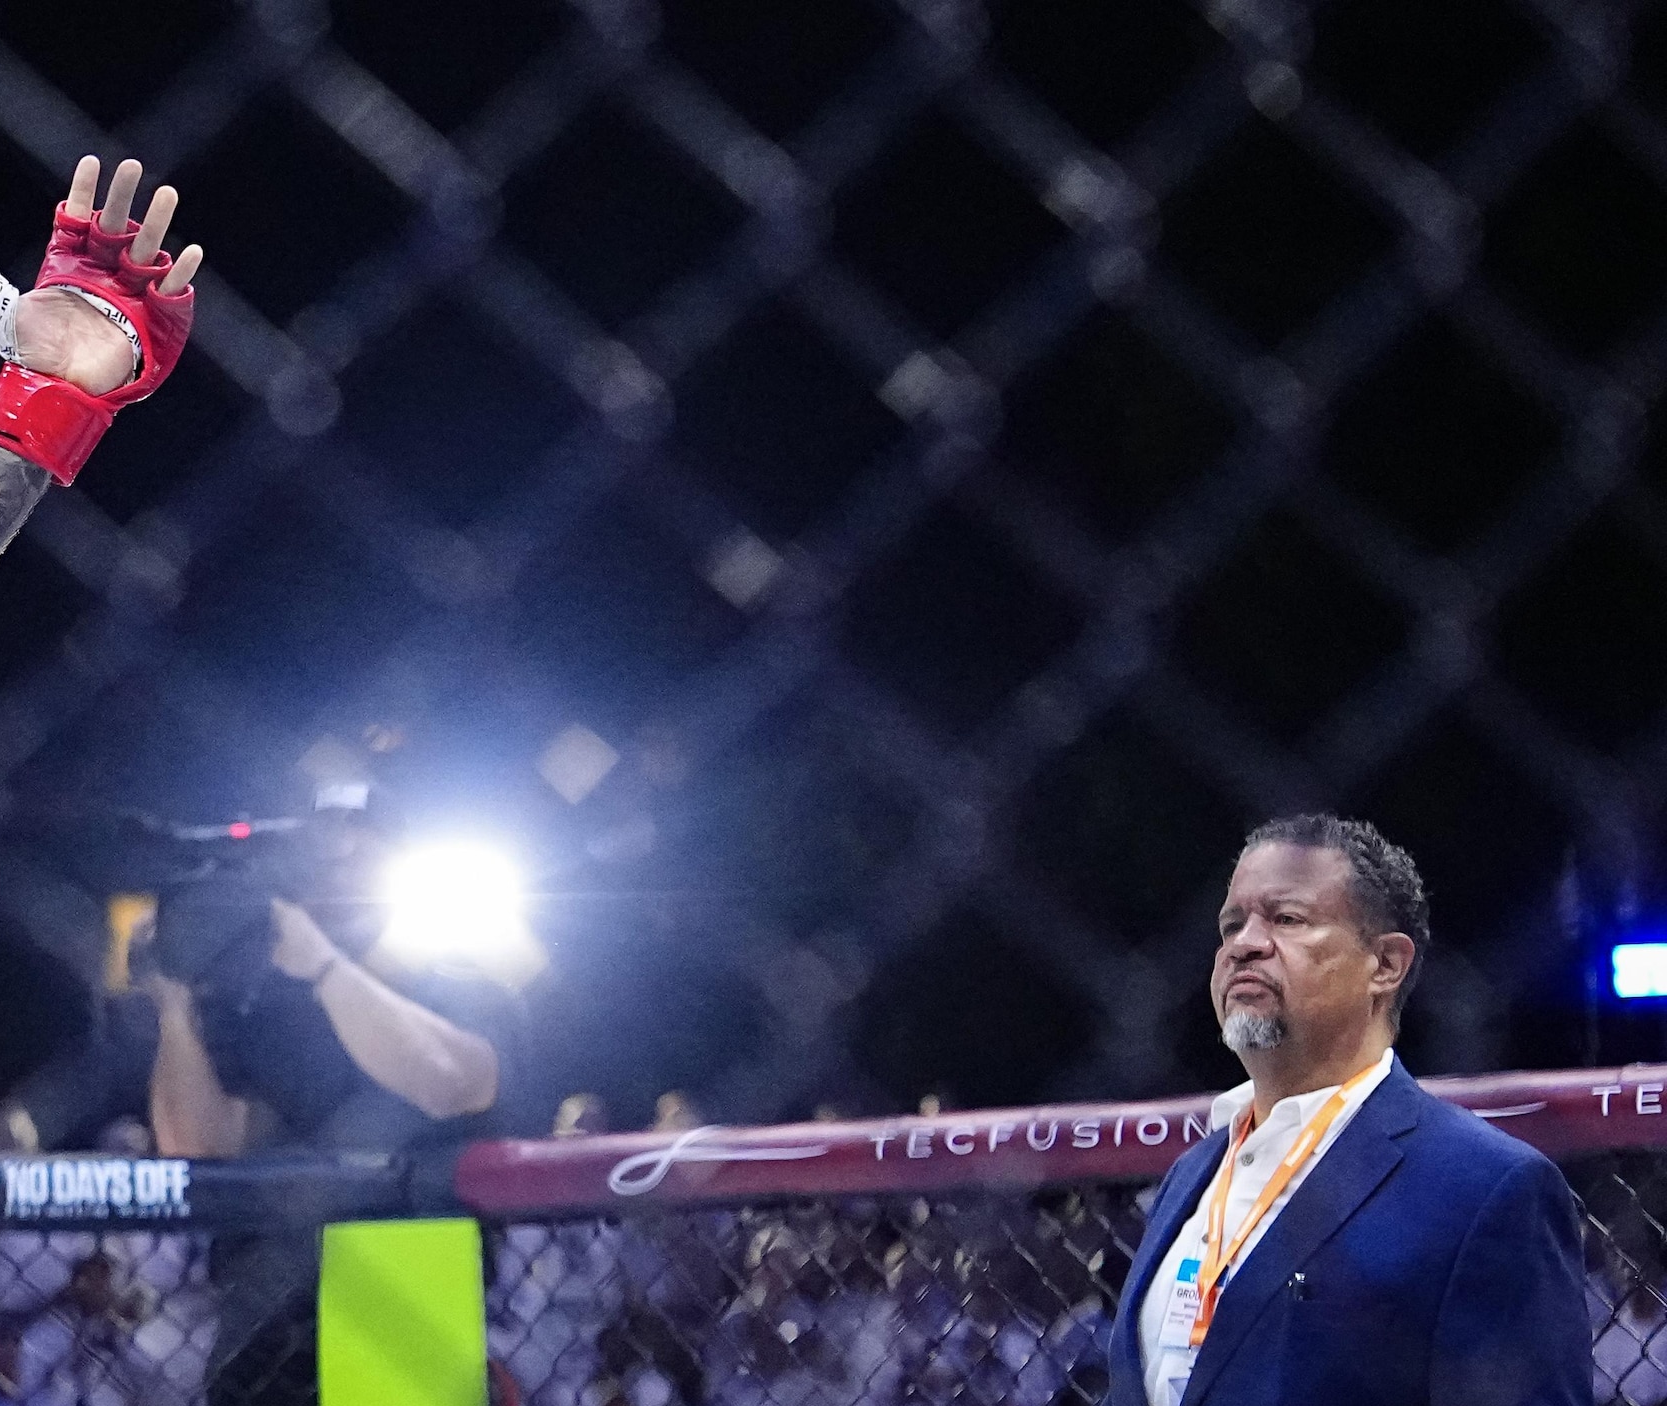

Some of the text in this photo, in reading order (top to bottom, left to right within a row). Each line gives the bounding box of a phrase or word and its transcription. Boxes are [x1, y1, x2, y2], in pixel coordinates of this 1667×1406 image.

[5, 1159, 190, 1206] NO DAYS OFF
